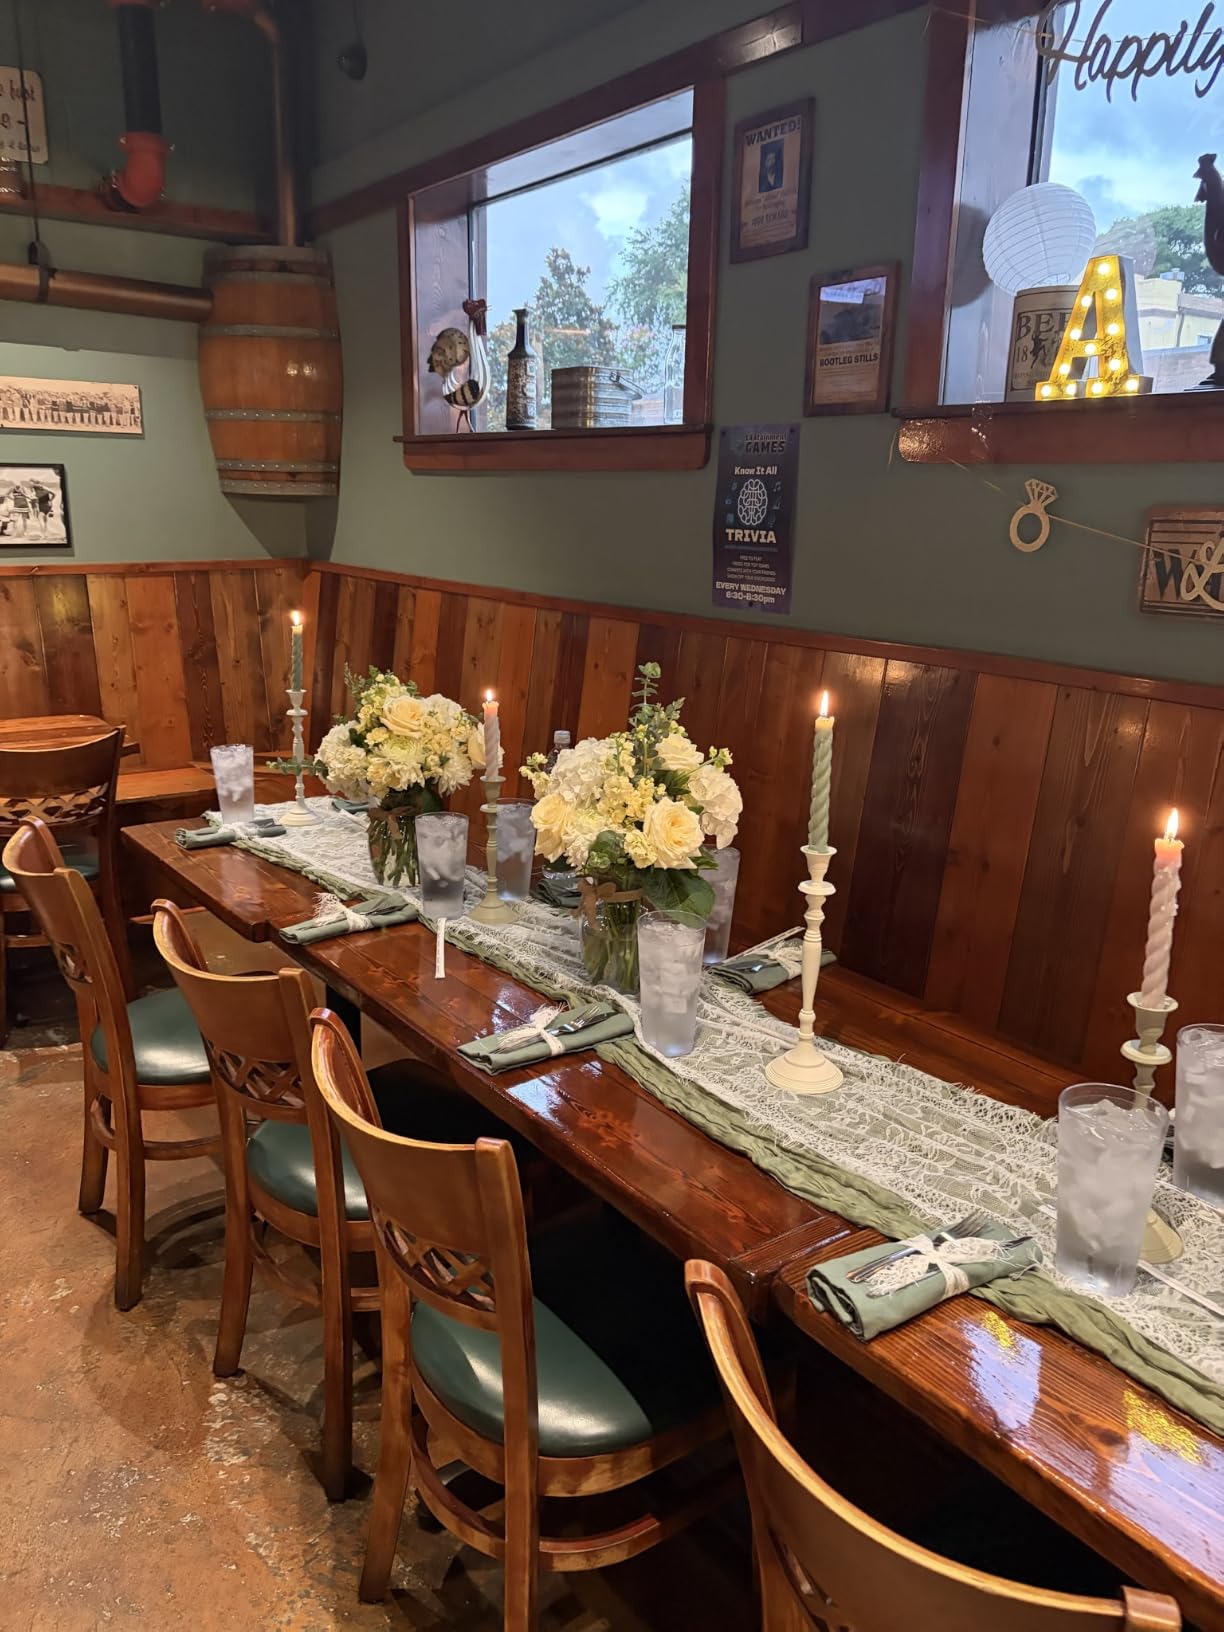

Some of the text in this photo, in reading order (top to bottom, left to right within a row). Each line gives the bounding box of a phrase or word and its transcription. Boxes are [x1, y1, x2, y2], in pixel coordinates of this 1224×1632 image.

[1036, 0, 1224, 103] Happily
[746, 119, 801, 146] WANTED!
[1034, 254, 1153, 400] A
[819, 352, 879, 367] BOOTLEG STILLS
[745, 440, 785, 454] GAMES
[734, 465, 777, 475] Know It All
[725, 528, 777, 543] TRIVIA
[715, 581, 787, 595] EVERY WEDNESDAY
[726, 591, 776, 605] 6:30-8:30pm
